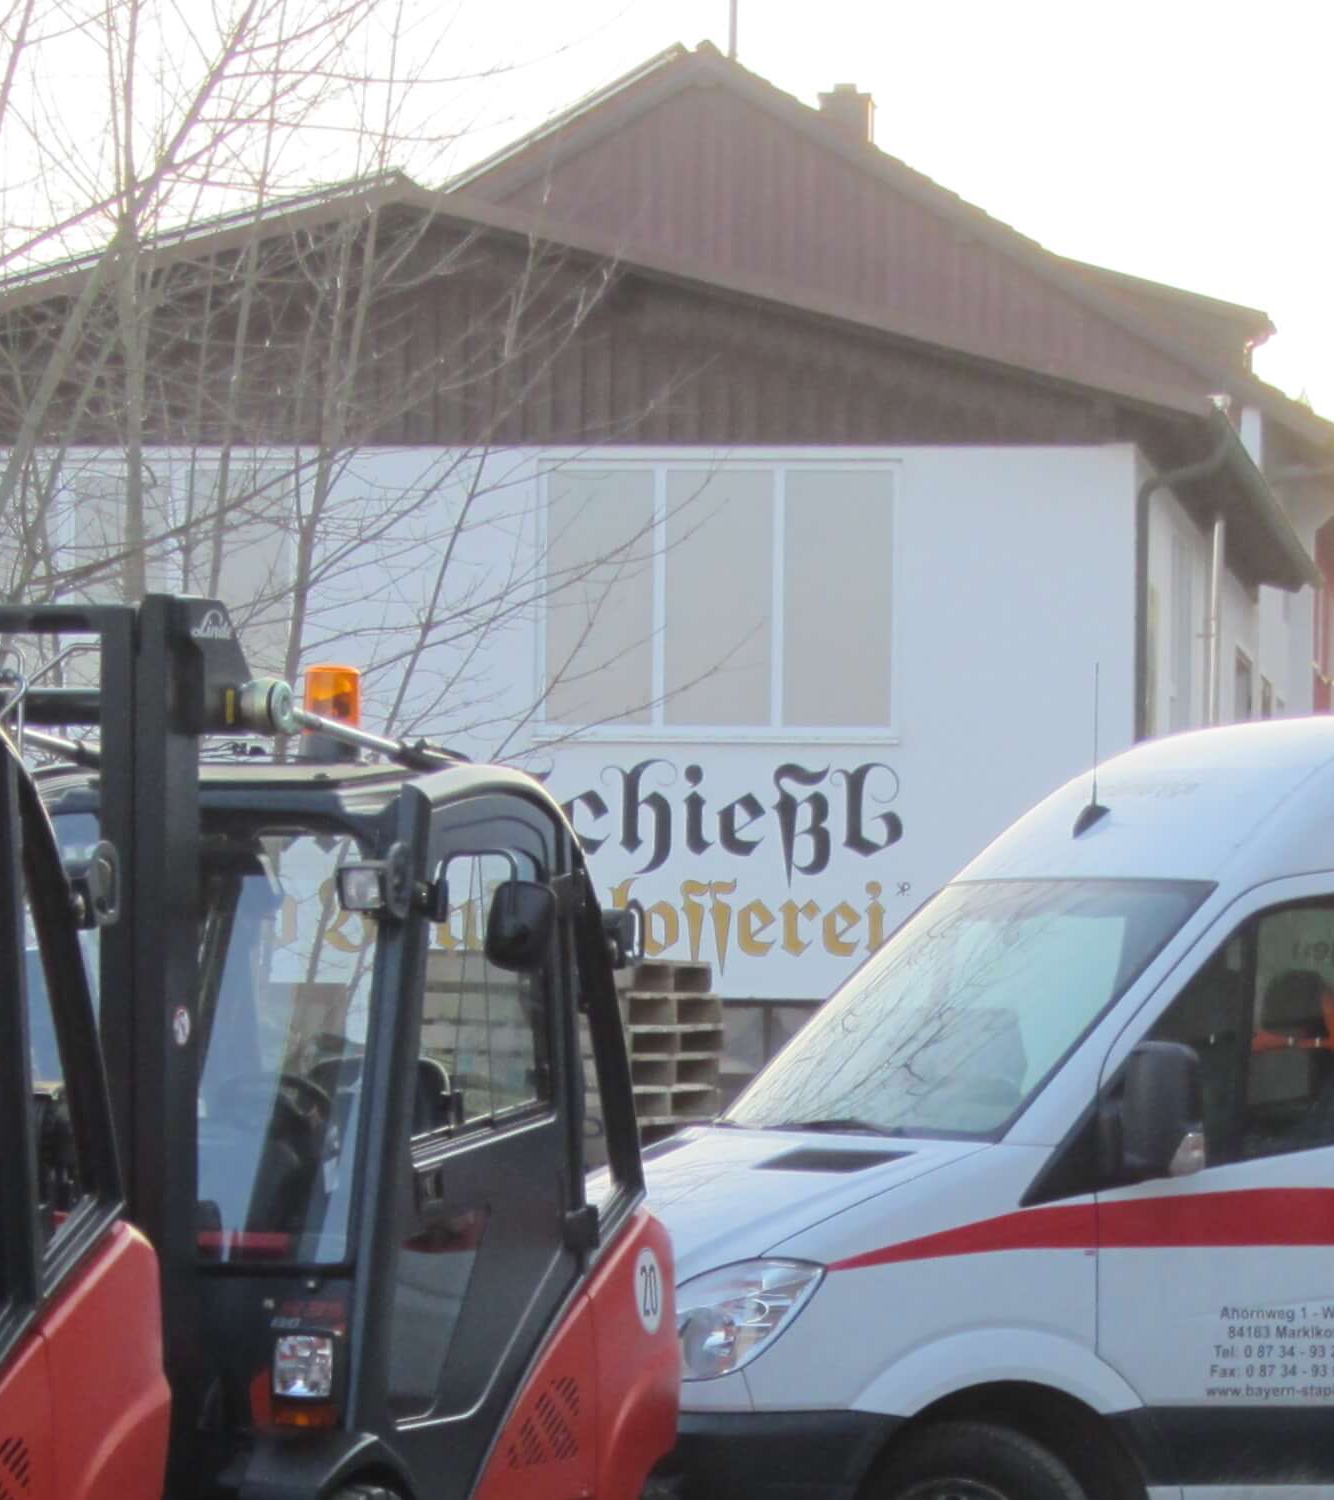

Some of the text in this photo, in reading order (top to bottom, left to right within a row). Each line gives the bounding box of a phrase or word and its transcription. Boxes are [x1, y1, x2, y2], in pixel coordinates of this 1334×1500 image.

[639, 1263, 659, 1317] 20
[1219, 1305, 1296, 1323] Ahornweg
[1299, 1306, 1308, 1320] 1
[1243, 1344, 1252, 1359] 0
[1257, 1344, 1274, 1359] 87
[1278, 1344, 1296, 1359] 34
[1308, 1344, 1326, 1359] 93
[1245, 1363, 1255, 1378] 0
[1258, 1363, 1276, 1378] 87
[1280, 1363, 1297, 1378] 34
